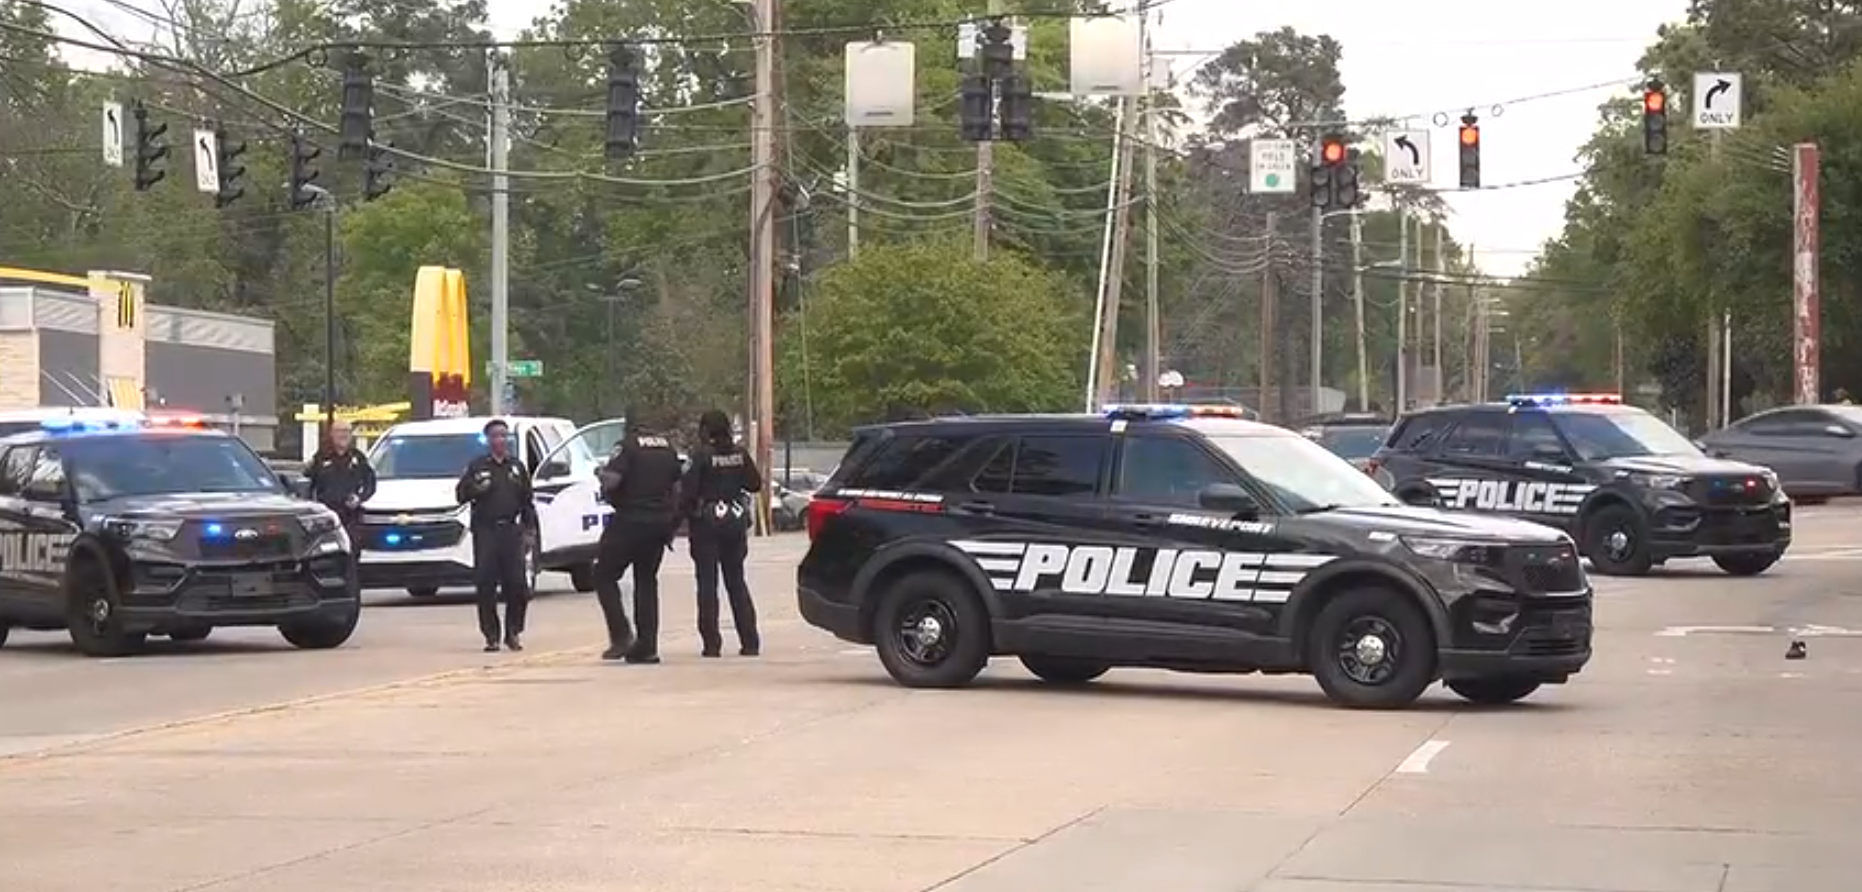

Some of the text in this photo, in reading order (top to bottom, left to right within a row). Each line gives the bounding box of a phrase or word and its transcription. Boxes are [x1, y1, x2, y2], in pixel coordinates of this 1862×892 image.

[1700, 112, 1733, 124] ONLY
[1391, 166, 1423, 178] ONLY
[711, 454, 744, 467] POLICE
[1455, 480, 1563, 512] POLICE
[0, 532, 62, 572] OLICE
[1013, 543, 1264, 602] POLICE
